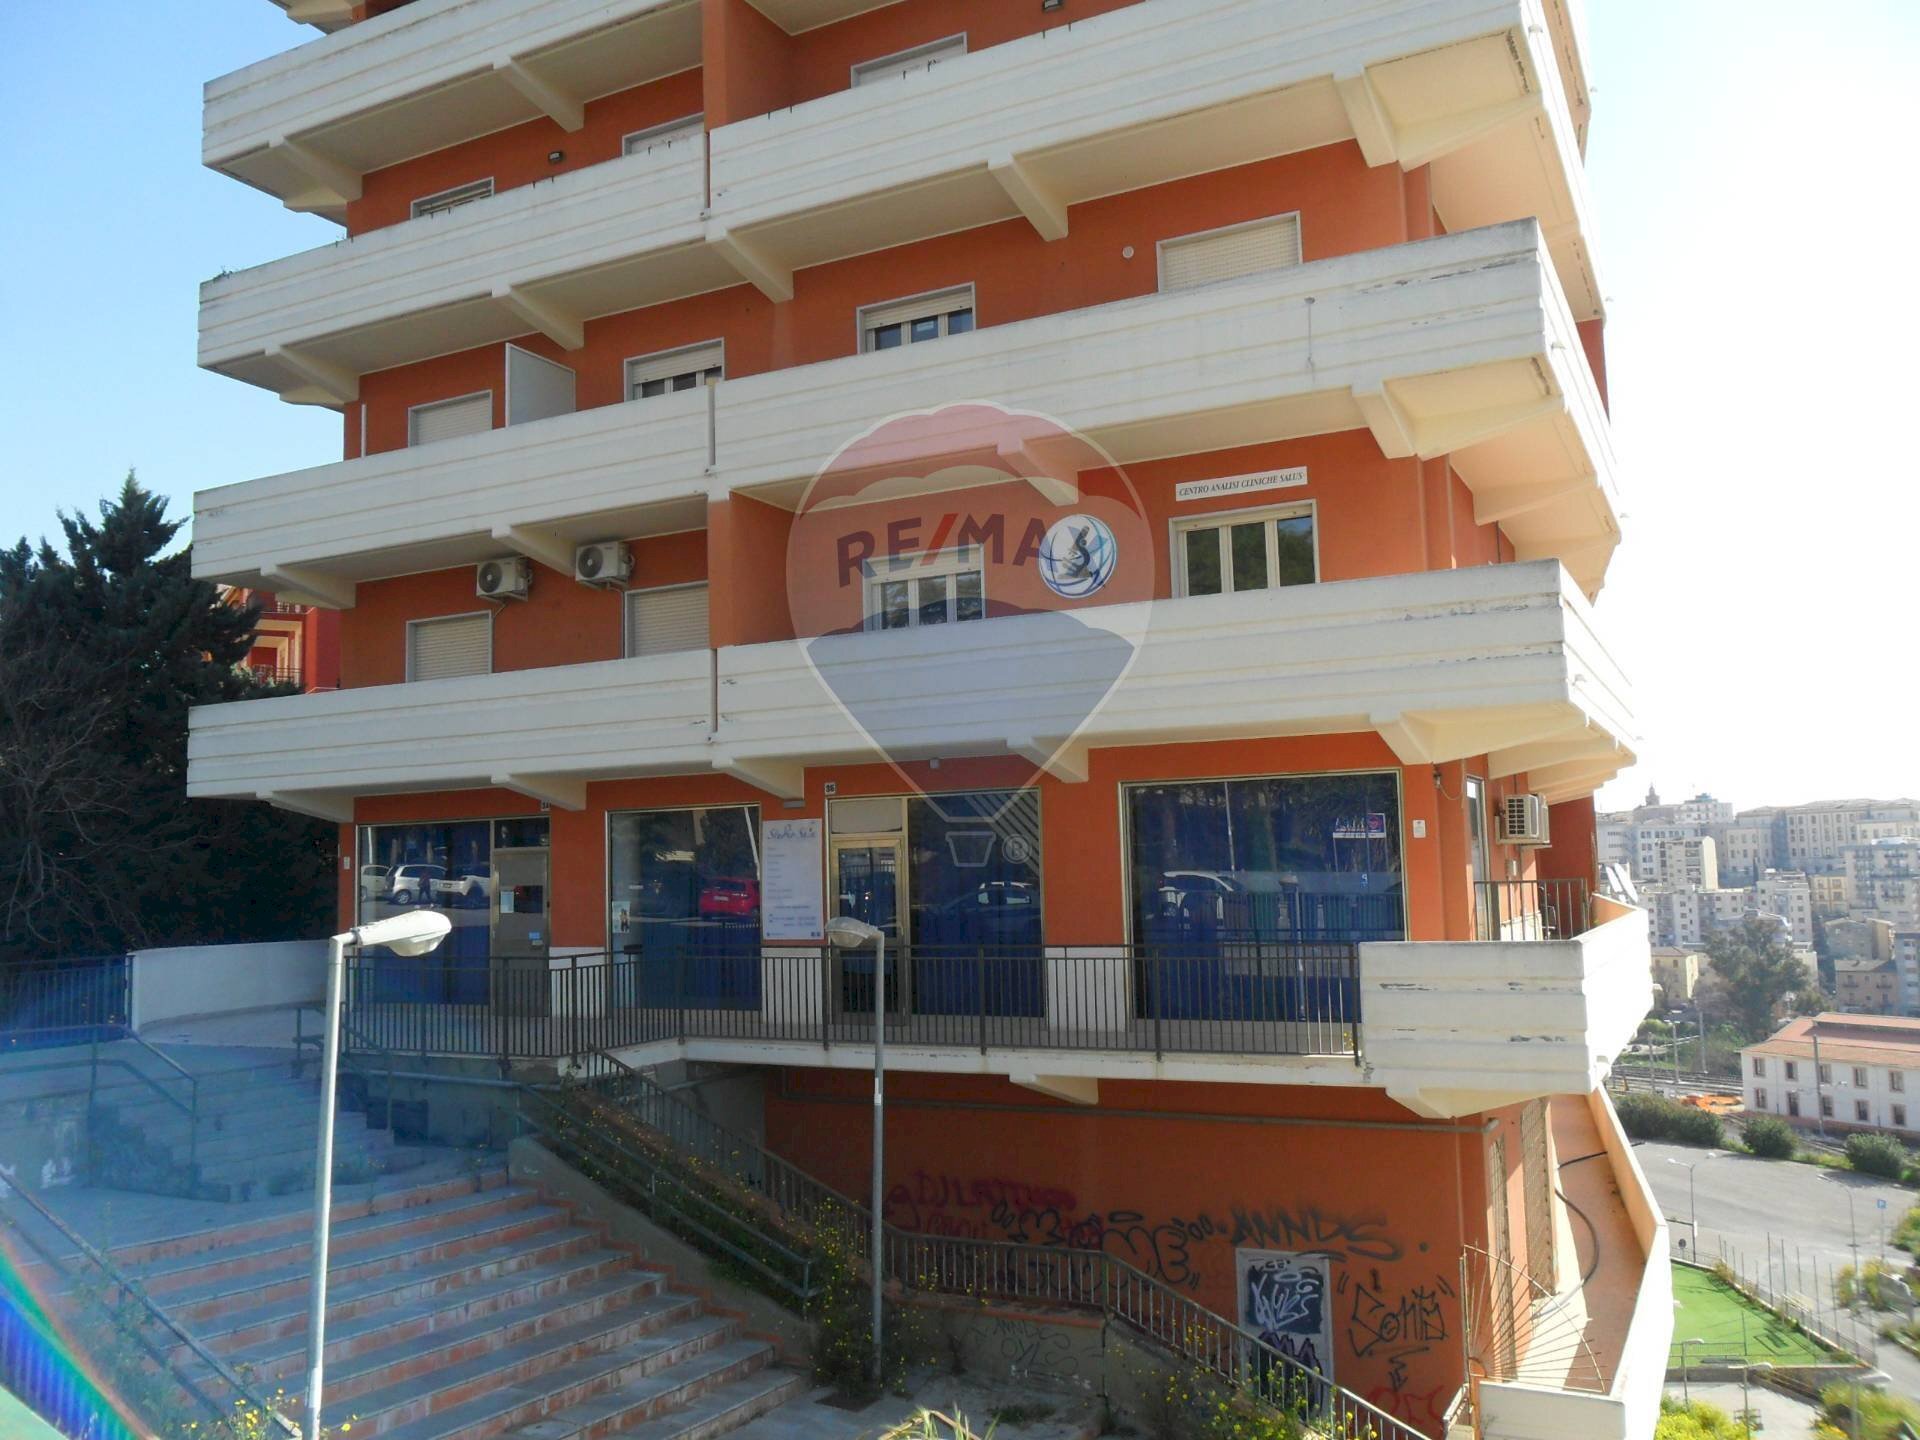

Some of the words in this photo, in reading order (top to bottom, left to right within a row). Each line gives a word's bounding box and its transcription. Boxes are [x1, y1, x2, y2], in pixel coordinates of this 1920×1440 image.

[1179, 485, 1209, 497] CENTRO
[1211, 480, 1239, 492] ANALISI
[1241, 474, 1278, 488] CLINICHE
[1280, 471, 1304, 481] SALUS
